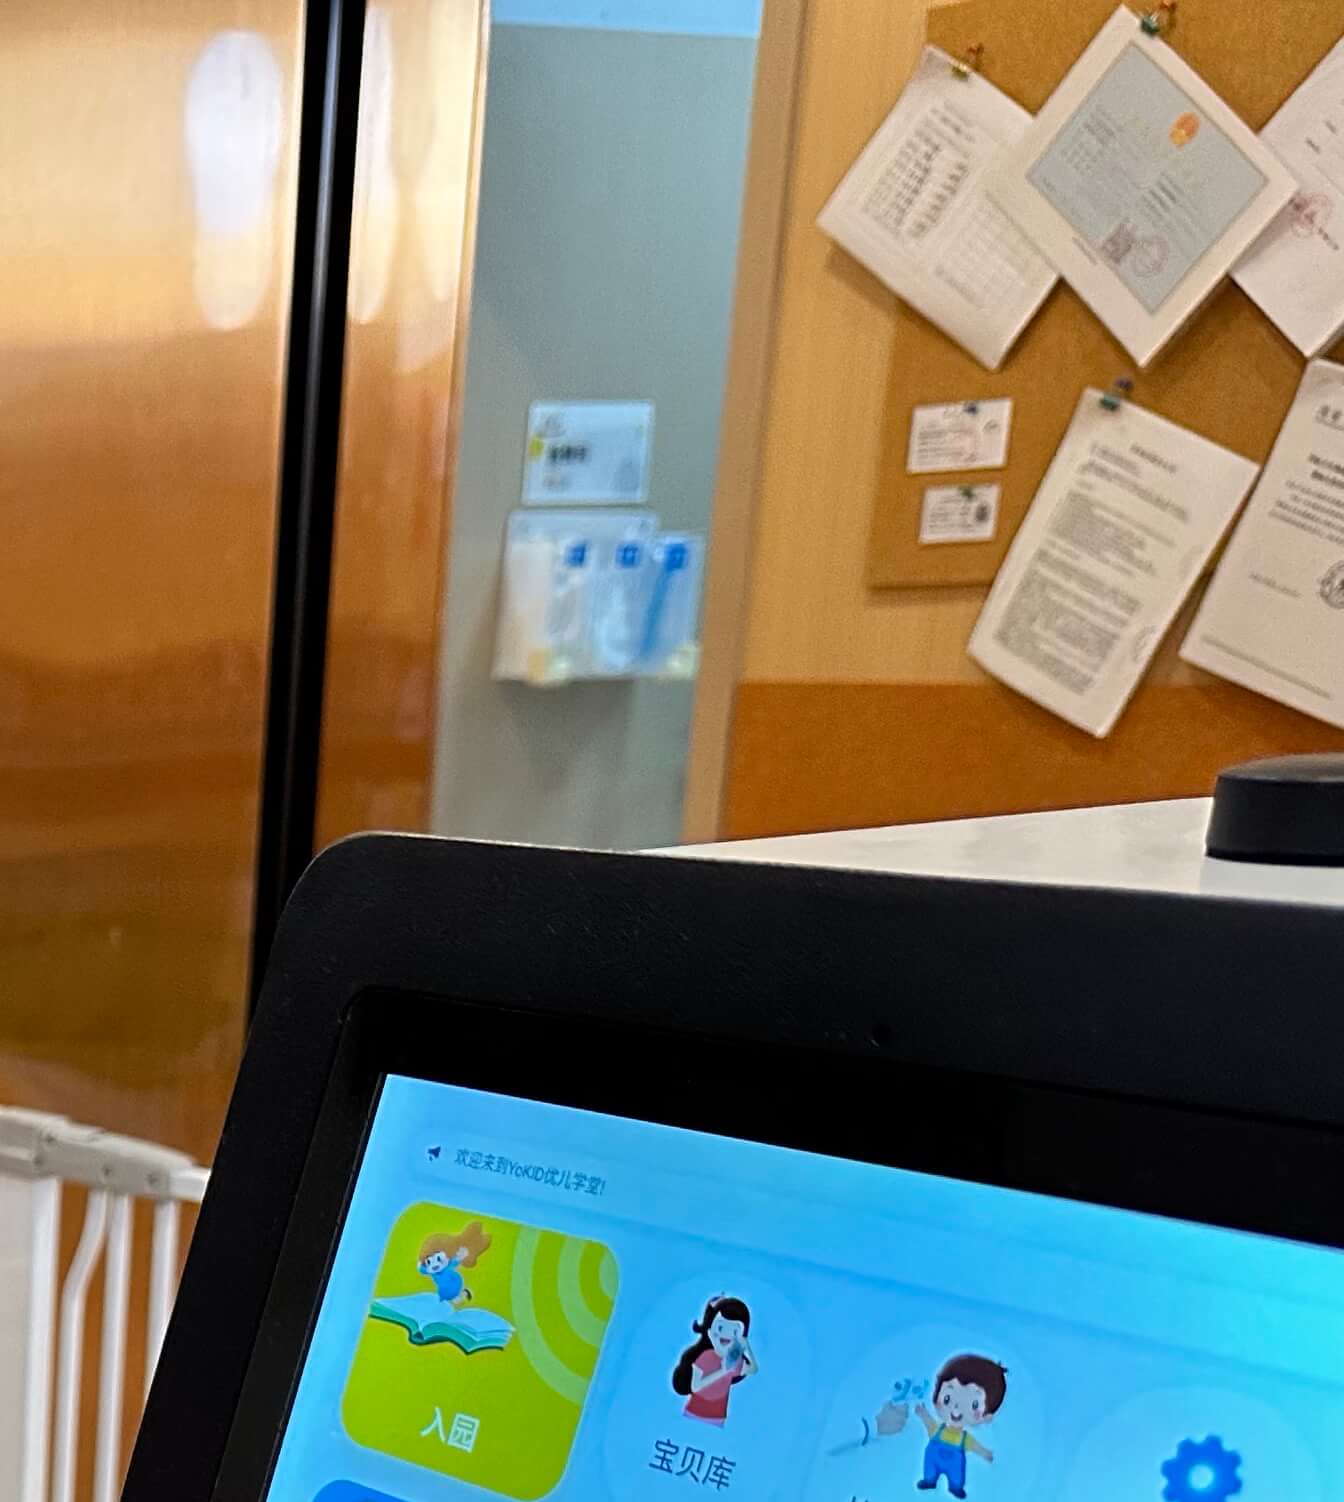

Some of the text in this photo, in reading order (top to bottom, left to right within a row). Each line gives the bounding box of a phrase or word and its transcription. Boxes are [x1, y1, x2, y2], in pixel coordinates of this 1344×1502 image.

[420, 1406, 480, 1453] 入园
[648, 1439, 736, 1491] 宝贝库
